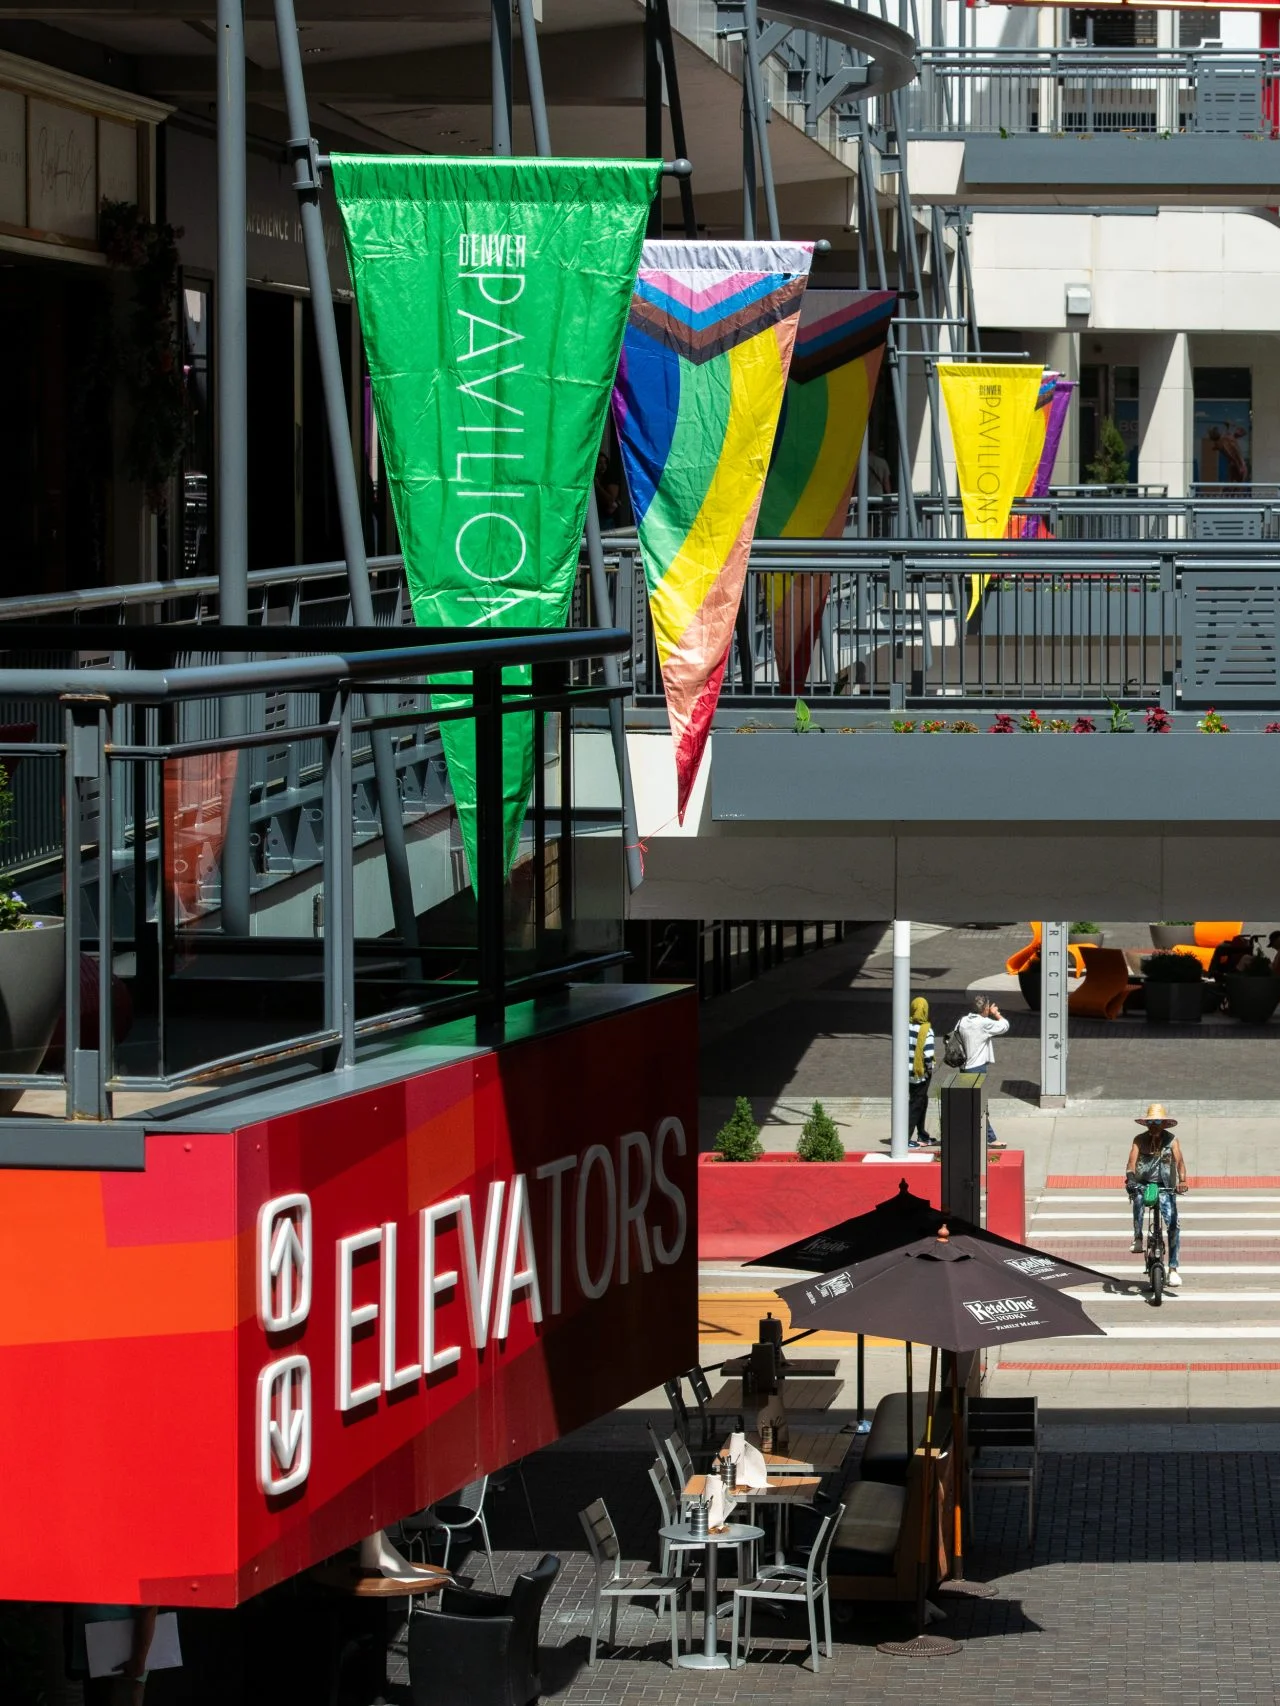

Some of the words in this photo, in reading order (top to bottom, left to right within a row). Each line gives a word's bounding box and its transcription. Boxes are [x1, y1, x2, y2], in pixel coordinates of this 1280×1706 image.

[457, 233, 526, 268] DENVER
[455, 272, 527, 628] PAVILION
[978, 385, 1002, 396] DENVER
[976, 397, 1002, 524] PAVILIONS
[1048, 929, 1059, 1060] RECTORY
[335, 1115, 688, 1413] ELEVATORS
[996, 1313, 1028, 1322] VODKA
